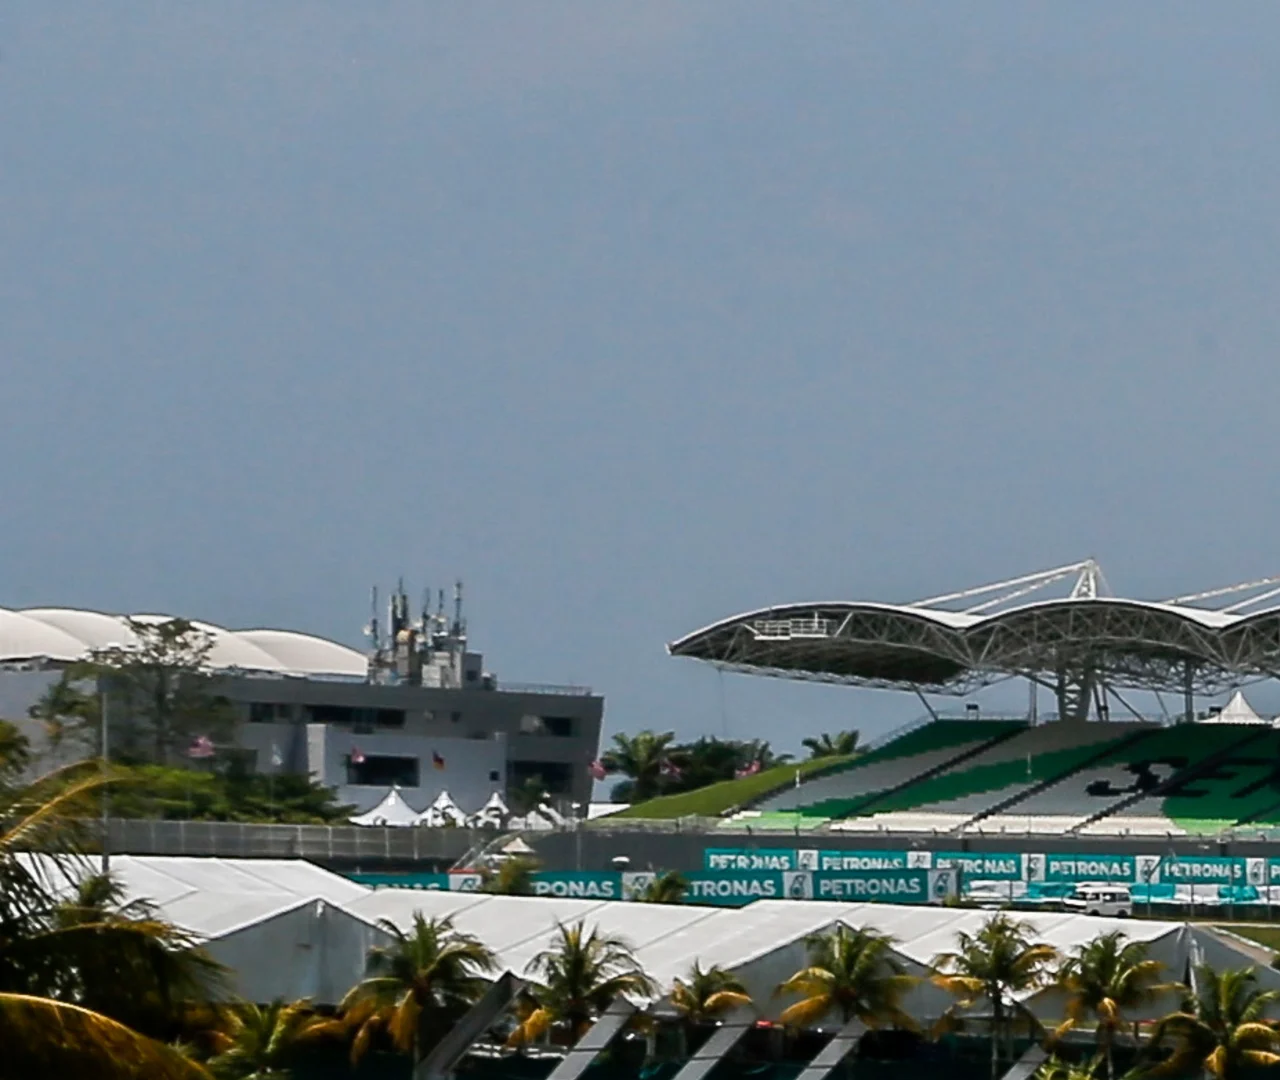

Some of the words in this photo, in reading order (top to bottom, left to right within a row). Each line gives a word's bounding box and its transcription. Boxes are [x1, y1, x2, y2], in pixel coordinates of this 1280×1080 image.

[1050, 861, 1131, 876] PETRONAS
[681, 880, 776, 897] TRONAS
[820, 877, 921, 896] PETRONAS
